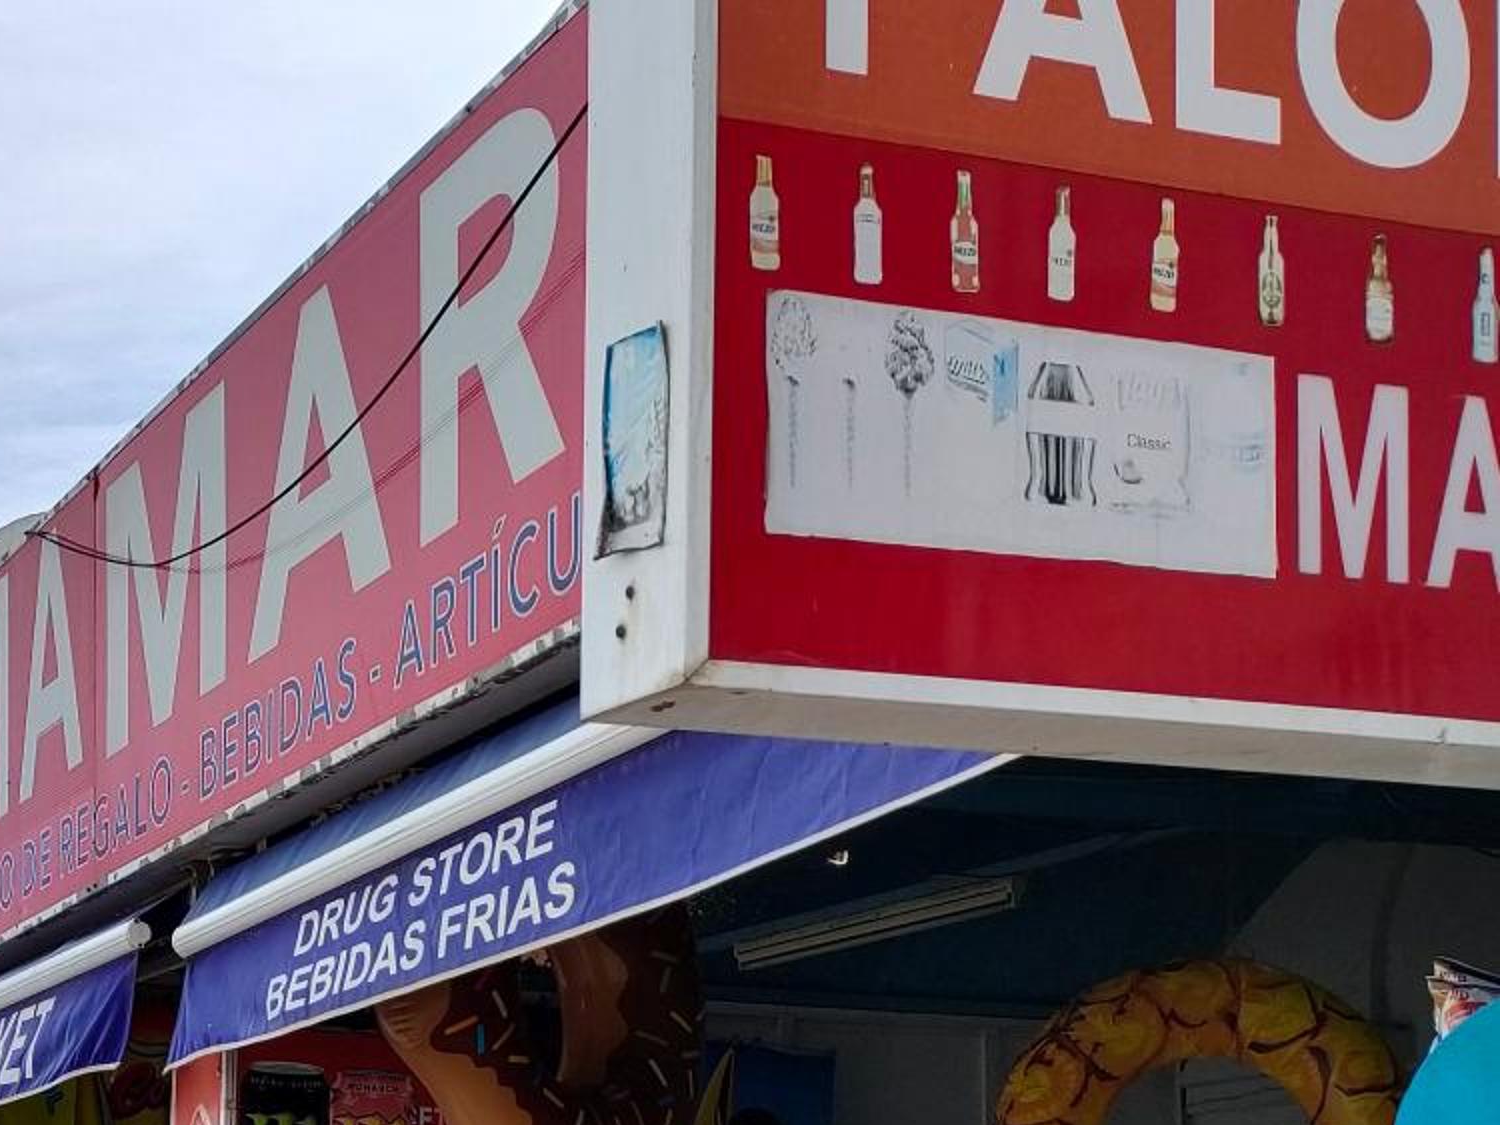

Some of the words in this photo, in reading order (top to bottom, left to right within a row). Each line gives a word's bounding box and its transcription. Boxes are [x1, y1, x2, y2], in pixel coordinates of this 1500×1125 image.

[825, 0, 1500, 168] ALO
[60, 754, 172, 871] REGALO
[200, 637, 359, 801] BEBIDAS
[266, 919, 426, 1021] BEBIDAS
[437, 861, 577, 960] FRIAS
[293, 874, 399, 957] DRUG
[408, 800, 559, 908] STORE
